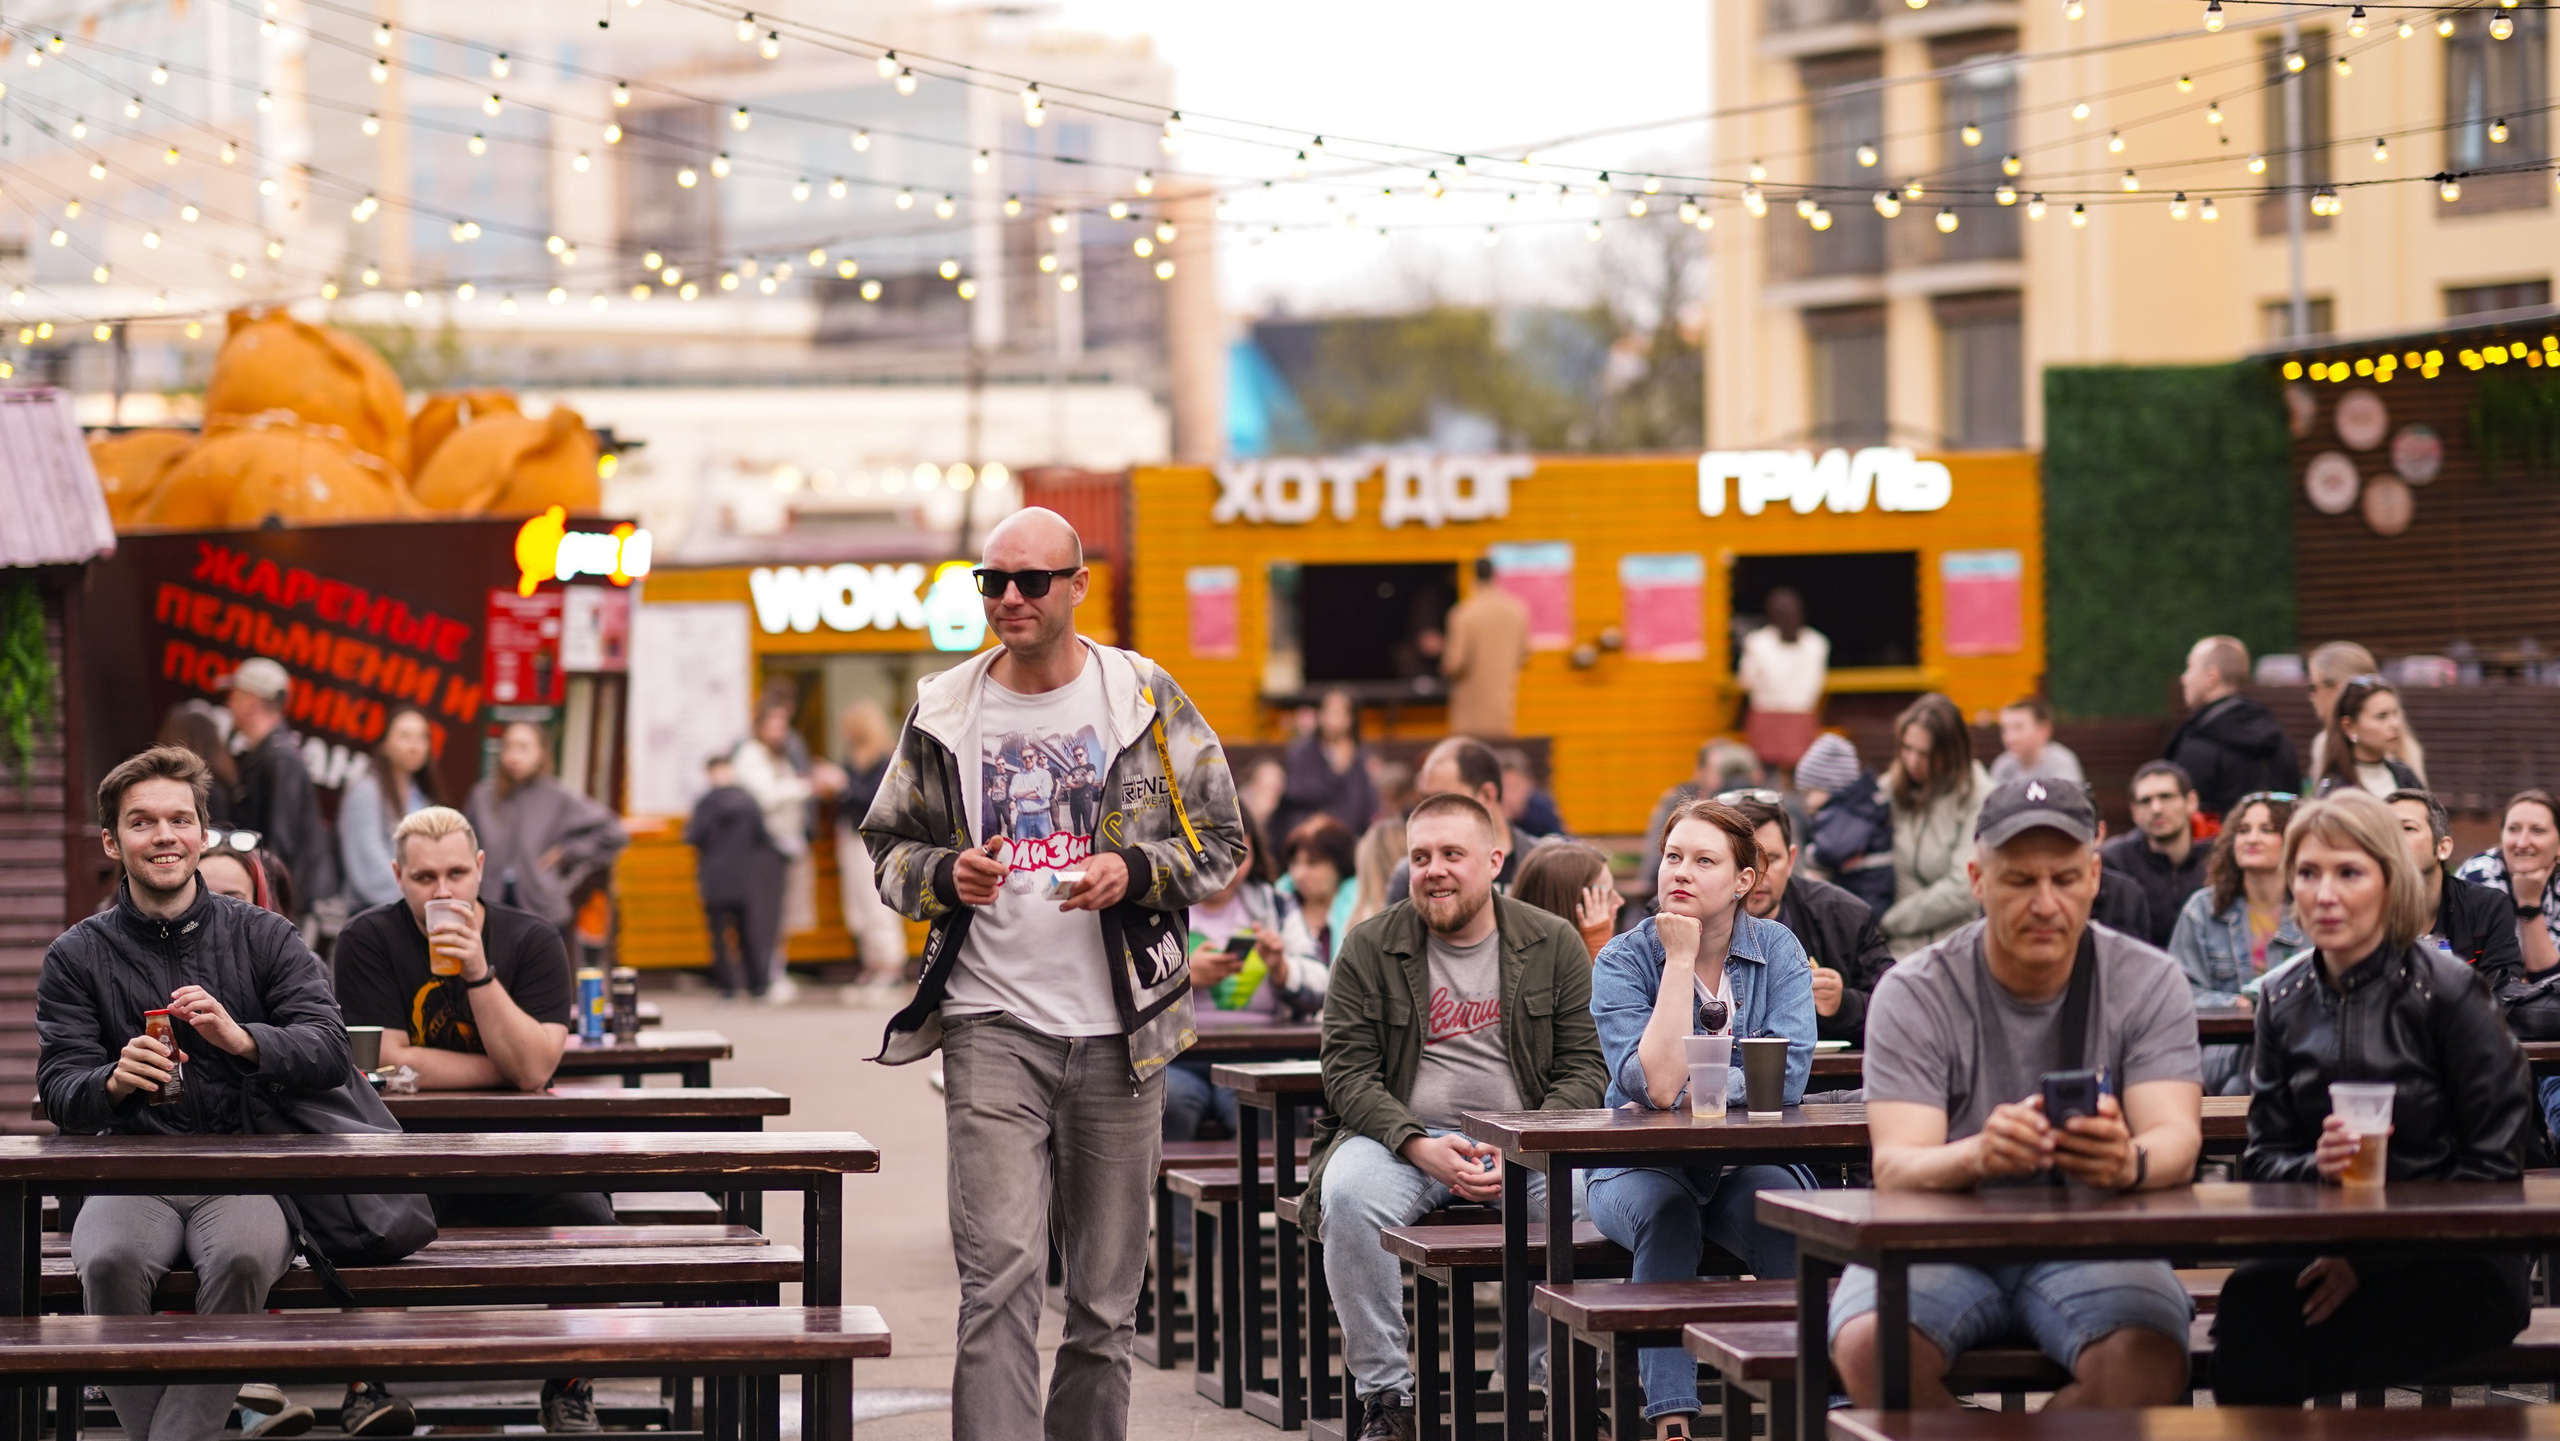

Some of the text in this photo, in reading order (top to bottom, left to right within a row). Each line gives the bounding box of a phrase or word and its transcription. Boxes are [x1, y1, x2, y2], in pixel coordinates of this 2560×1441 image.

[1211, 451, 1537, 530] ХОТ ДОГ
[1698, 447, 1953, 517] ГРИЛЬ
[193, 540, 470, 663] ЖАРЕНЫЕ
[749, 562, 927, 634] WOK
[156, 582, 440, 706] ПЕЛЬМЕНИ
[442, 675, 482, 723] И
